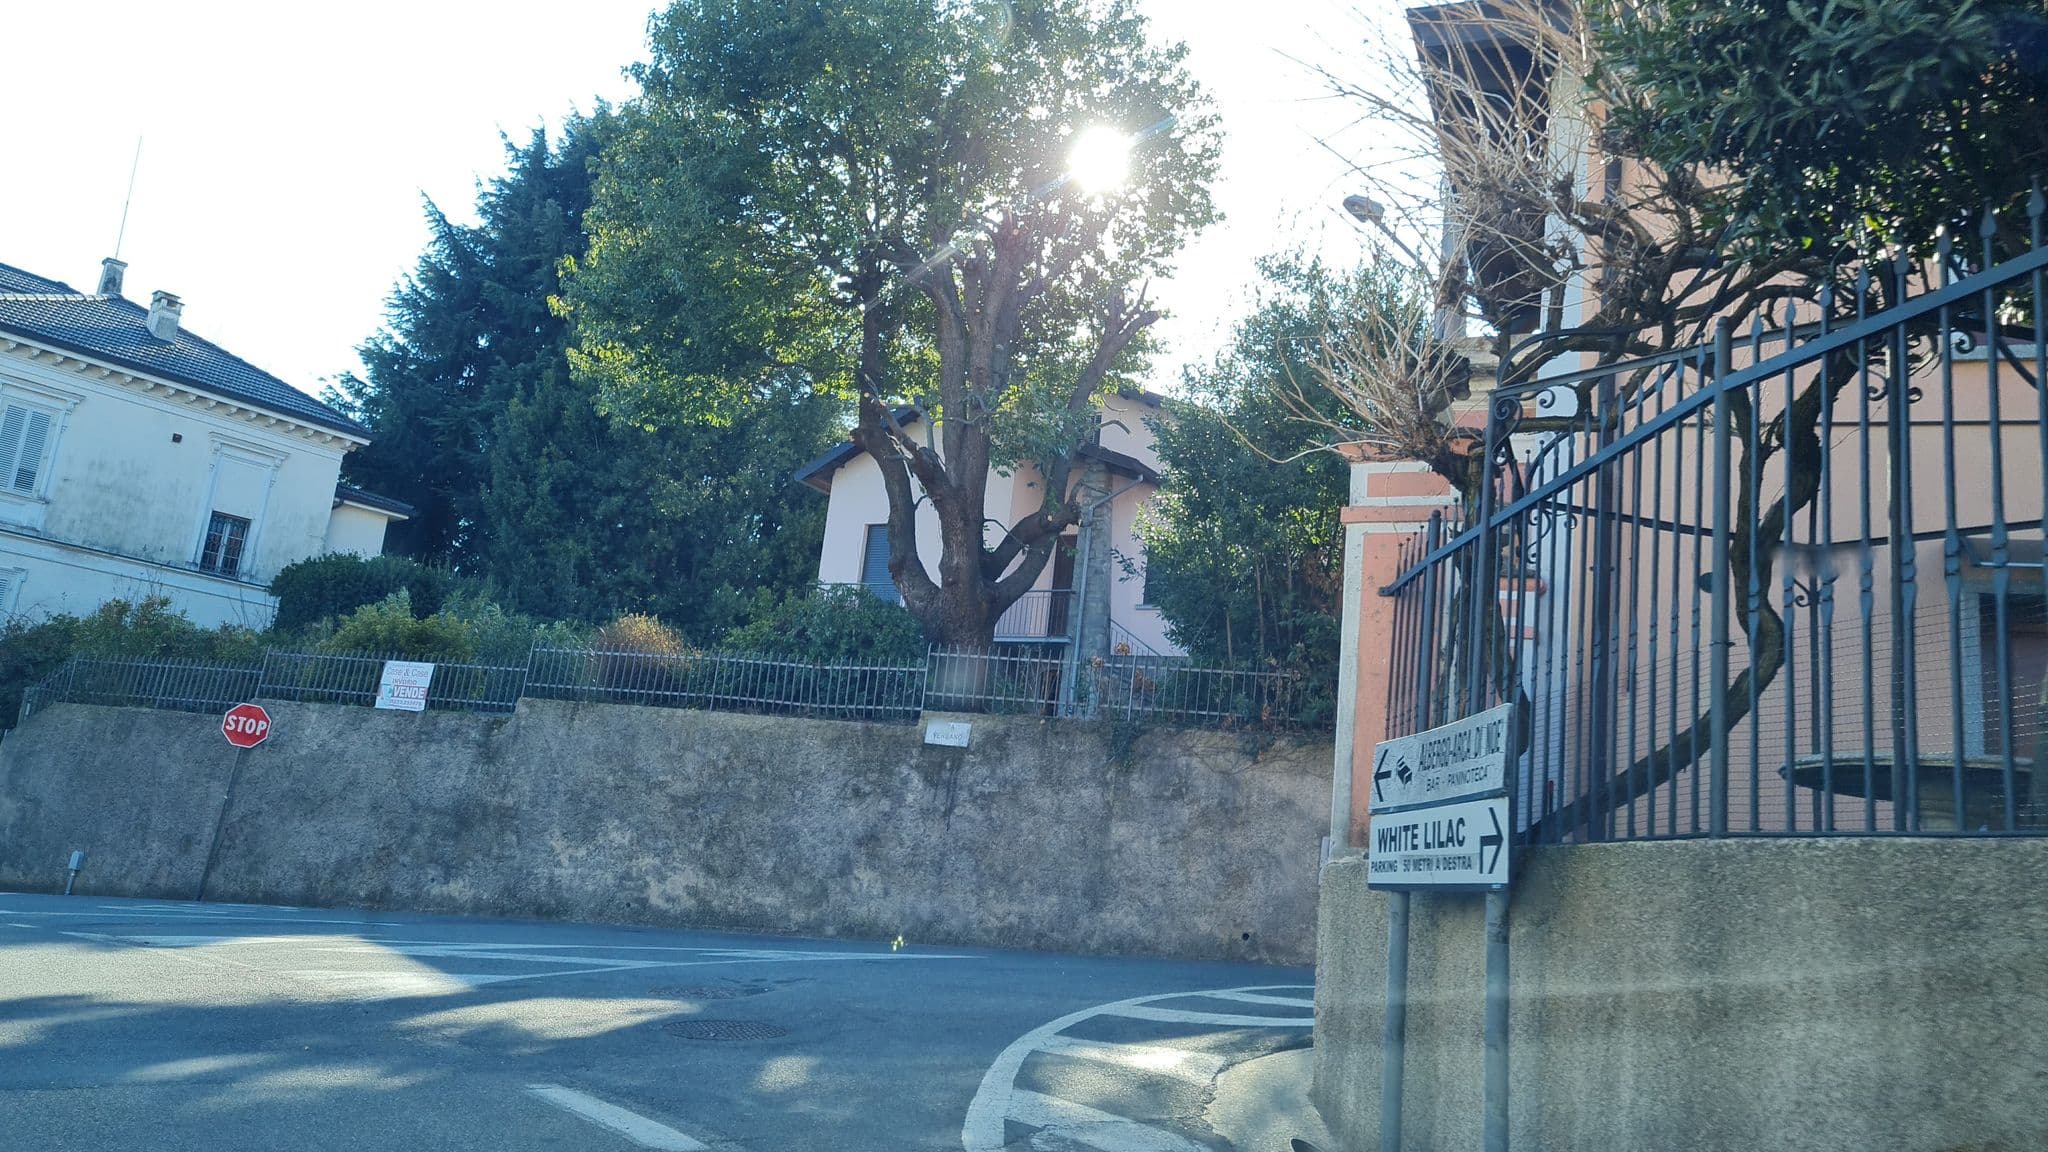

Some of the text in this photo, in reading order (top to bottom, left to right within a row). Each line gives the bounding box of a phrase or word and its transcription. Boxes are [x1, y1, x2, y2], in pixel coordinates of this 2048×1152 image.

[394, 685, 425, 699] VENDE
[226, 715, 267, 735] STOP
[1426, 776, 1440, 792] BAR
[1448, 766, 1488, 786] PANINOTECA
[1378, 817, 1466, 853] WHITE LILAC
[1371, 860, 1398, 873] PARKING
[1412, 858, 1433, 872] METRI
[1434, 857, 1441, 871] A
[1442, 856, 1472, 871] DESTRA
